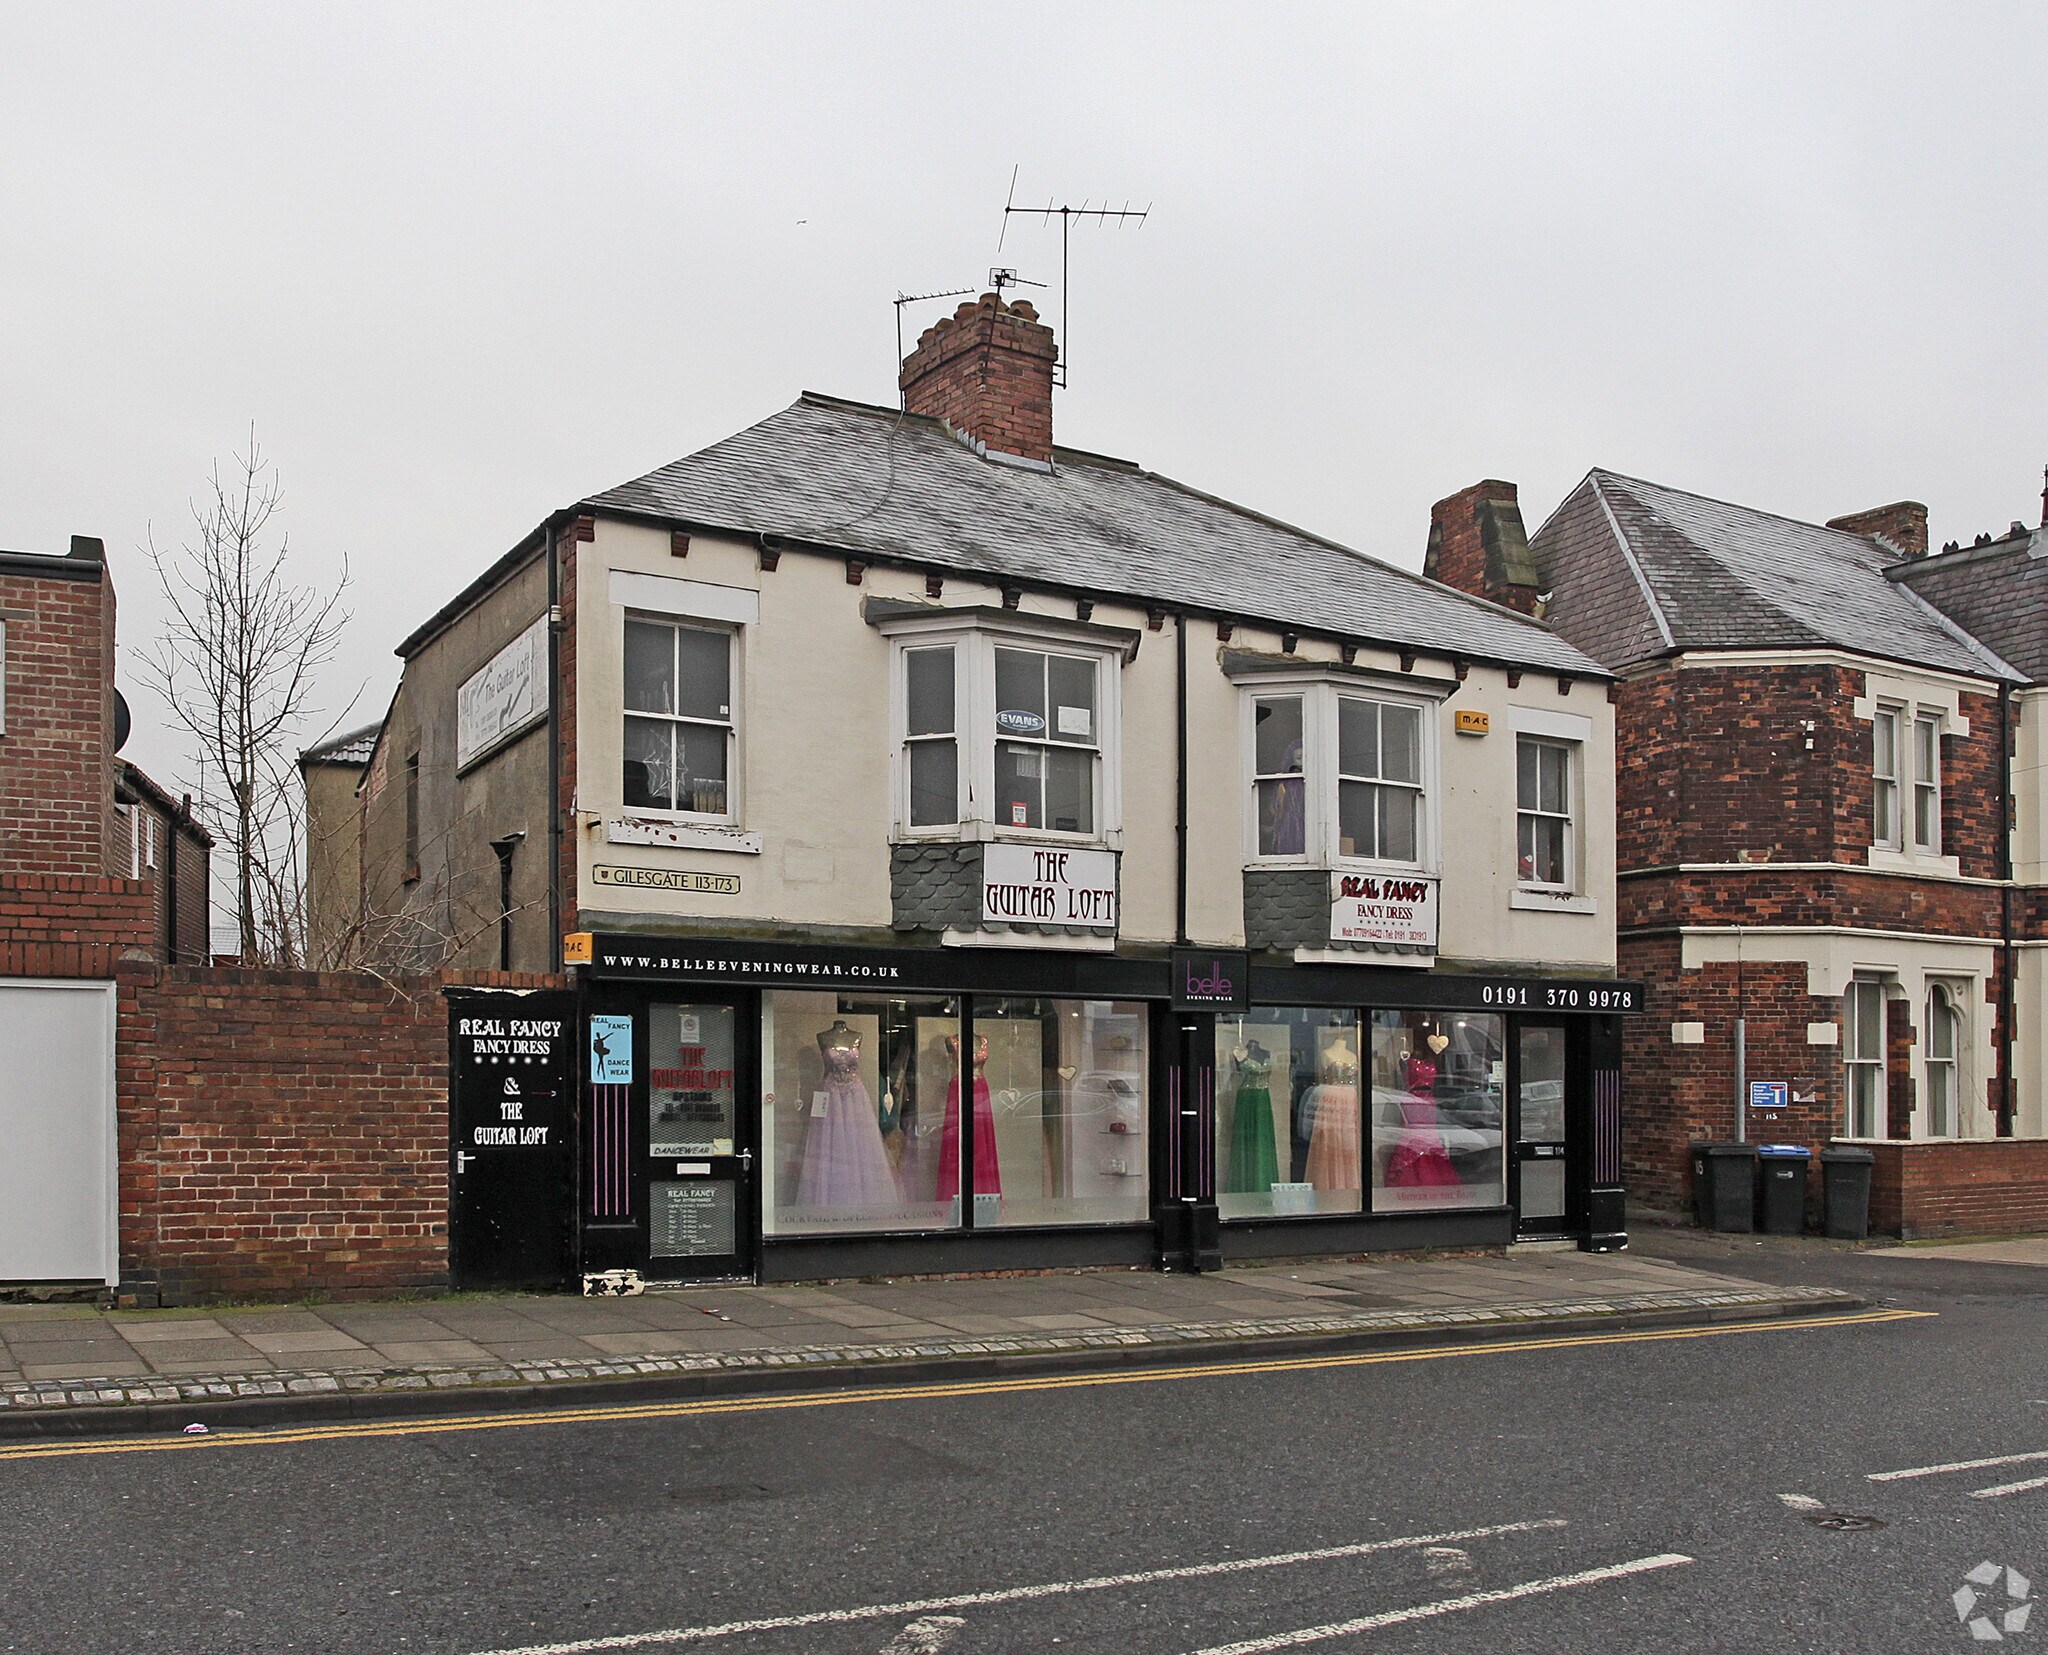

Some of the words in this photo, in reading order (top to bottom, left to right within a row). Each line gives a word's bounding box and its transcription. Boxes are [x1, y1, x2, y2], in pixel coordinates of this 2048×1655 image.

[485, 680, 495, 703] The
[496, 667, 514, 695] Guitar
[515, 651, 530, 679] Loft
[1001, 714, 1039, 726] EVANS
[1033, 851, 1069, 884] THE
[614, 869, 688, 888] GILESGATE
[695, 876, 733, 891] 113-173
[1340, 876, 1380, 899] REAL
[1382, 879, 1428, 903] FANCY
[985, 884, 1056, 921] GUITAR
[1066, 888, 1115, 921] LOFT
[1357, 903, 1384, 919] FANCY
[1386, 906, 1413, 920] DRESS
[603, 955, 899, 977] WWW.BELLEEVENINGWEAR.CO.UK
[1187, 960, 1232, 995] belle
[1482, 986, 1527, 1005] 0191
[1547, 988, 1579, 1006] 370
[1589, 990, 1632, 1008] 9978
[459, 1018, 505, 1035] REAL
[510, 1020, 561, 1037] FANCY
[473, 1039, 512, 1054] FANCY
[513, 1040, 550, 1055] DRESS
[679, 1046, 706, 1067] THE
[503, 1077, 521, 1095] &
[500, 1102, 523, 1120] THE
[474, 1127, 517, 1145] GUITAR
[520, 1127, 548, 1145] LOFT
[654, 1146, 710, 1155] DANCEWEAR
[690, 1189, 716, 1197] FANCY
